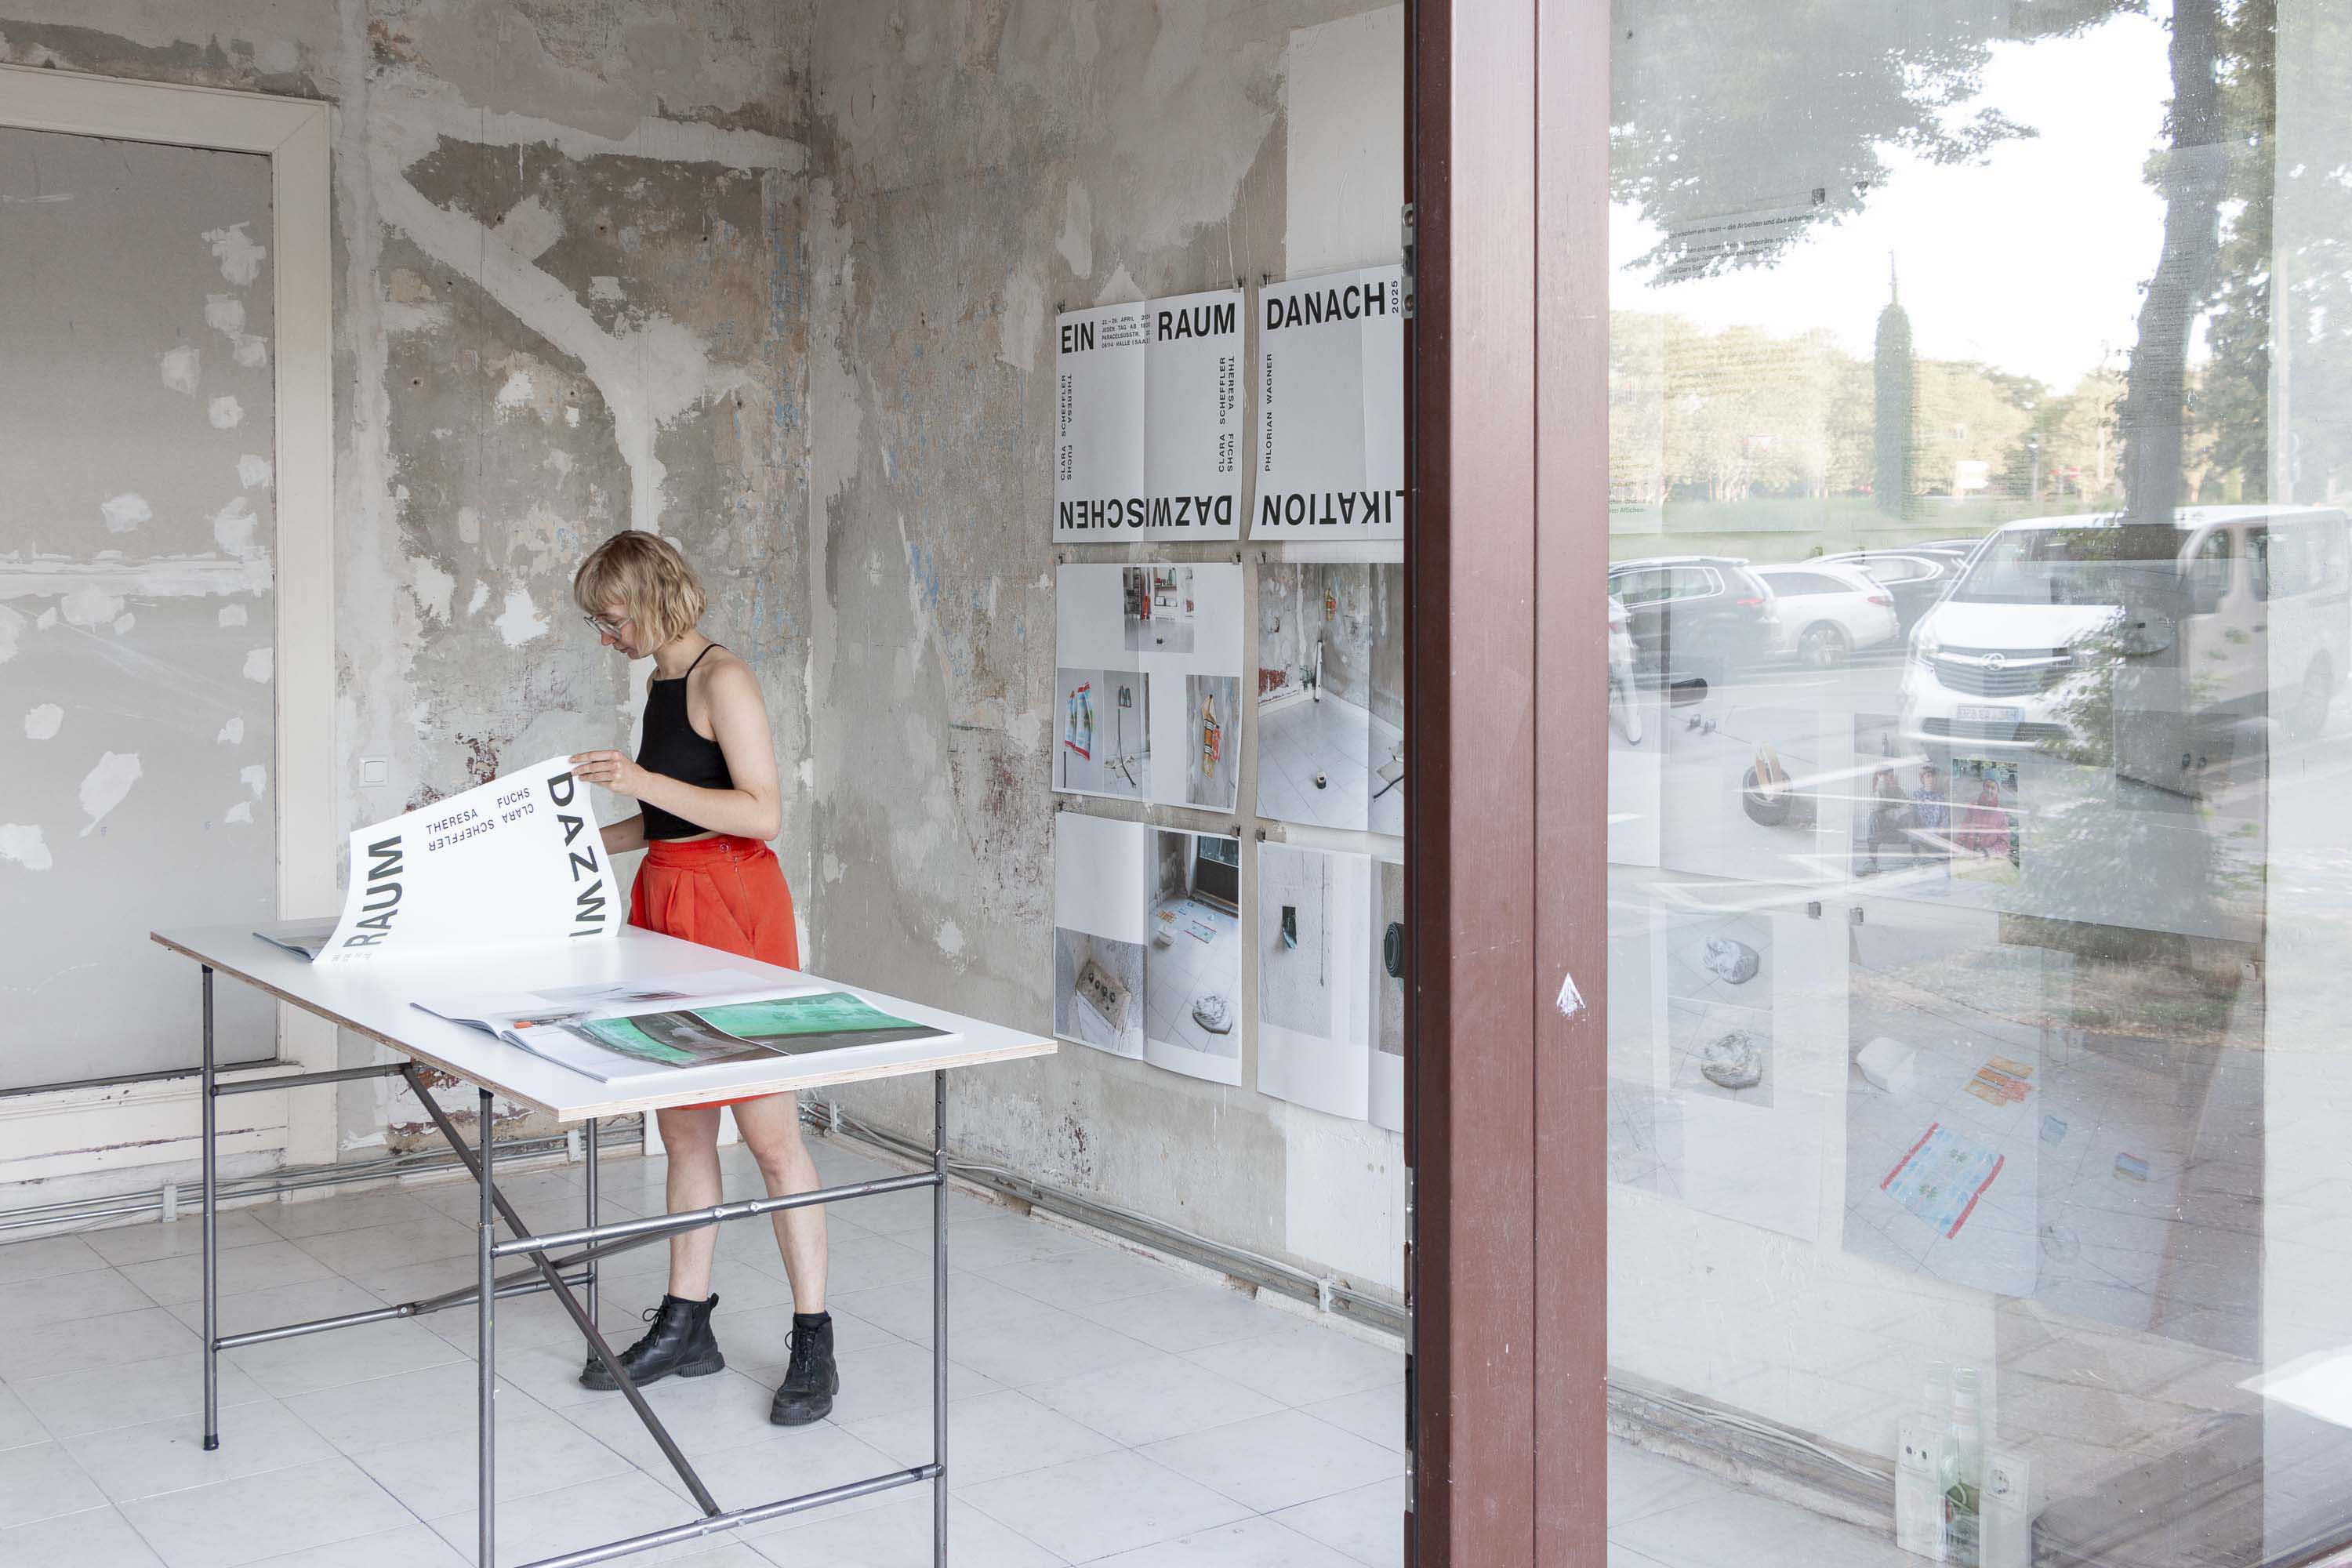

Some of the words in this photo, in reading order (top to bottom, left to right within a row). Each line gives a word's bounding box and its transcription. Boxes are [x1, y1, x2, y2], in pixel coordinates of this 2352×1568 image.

[1737, 220, 1763, 229] Arbeiten
[1788, 213, 1814, 223] Arbeiten
[1158, 303, 1236, 342] RAUM
[1265, 282, 1385, 330] DANACH
[1061, 321, 1094, 354] EIN
[1060, 495, 1232, 530] DAZWISCHEN
[426, 808, 478, 835] THERESA
[497, 787, 530, 809] FUCHS
[501, 803, 535, 823] CLARA
[427, 818, 495, 851] SCHEFFLER
[343, 835, 404, 948] RAUM
